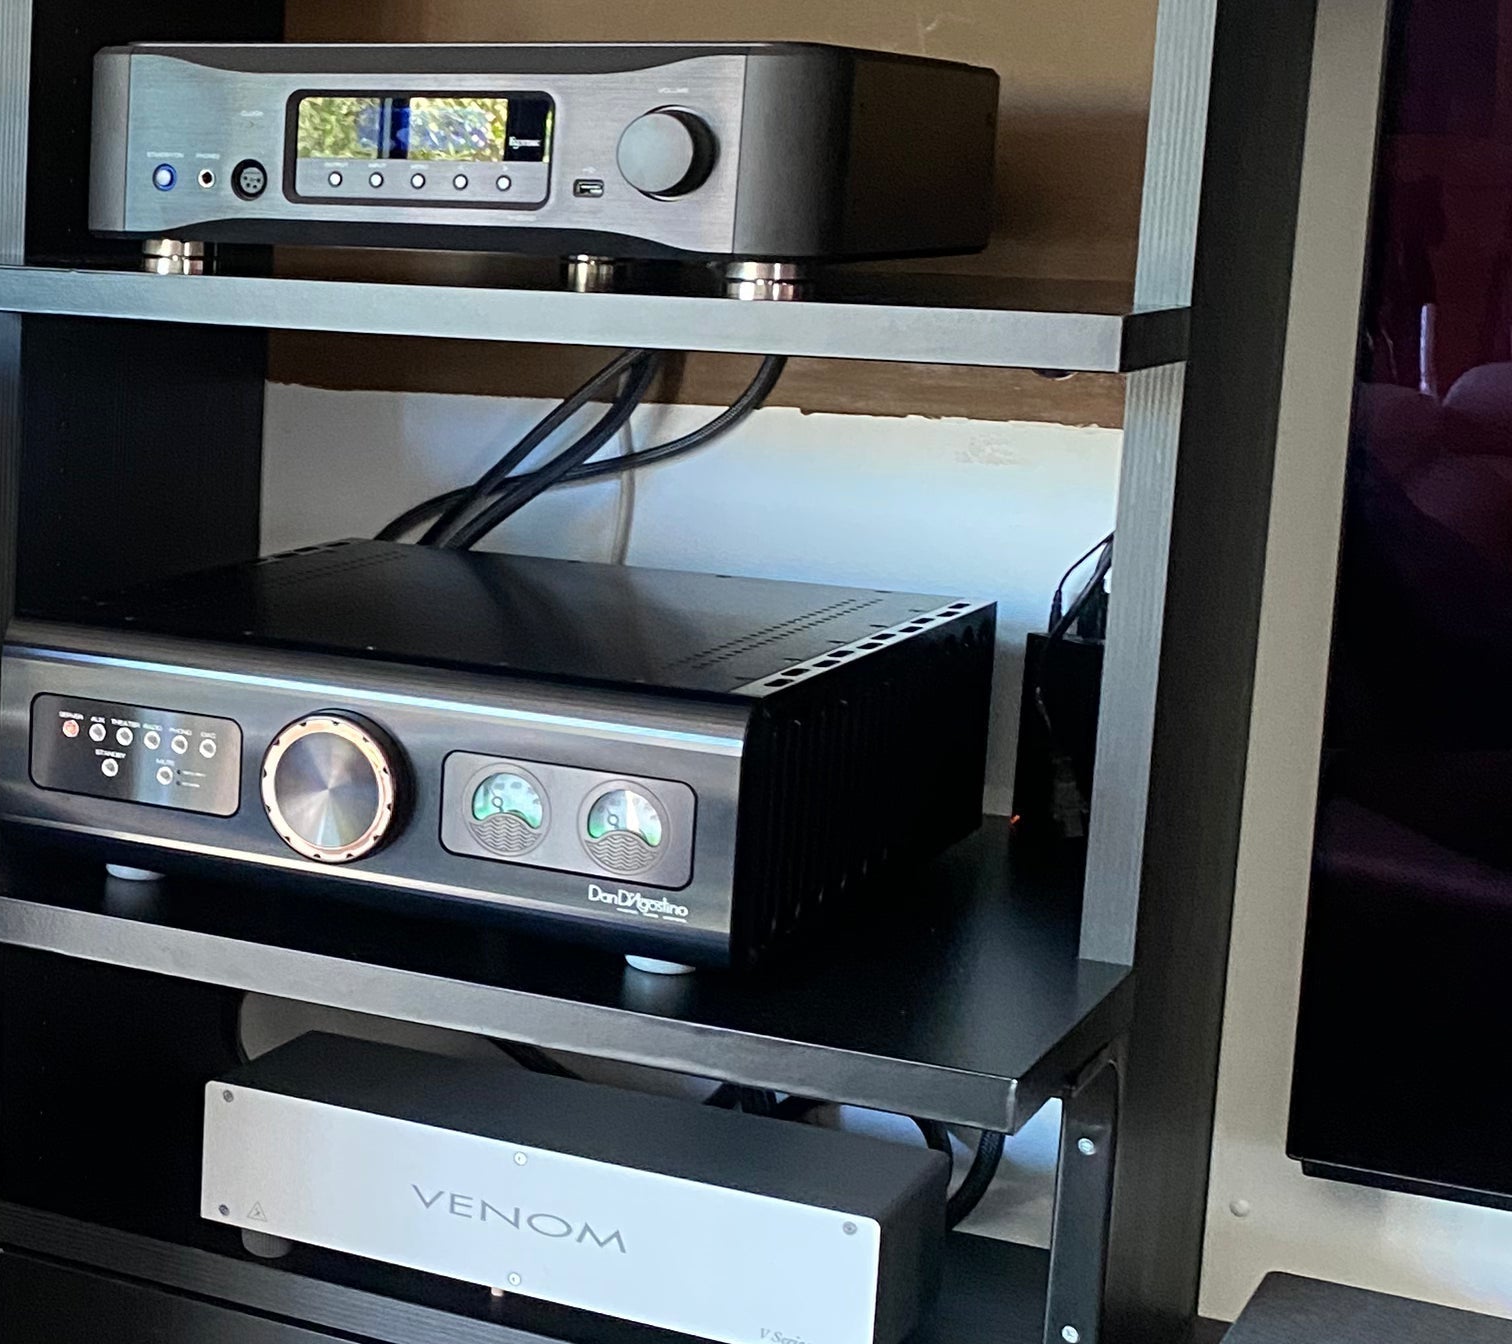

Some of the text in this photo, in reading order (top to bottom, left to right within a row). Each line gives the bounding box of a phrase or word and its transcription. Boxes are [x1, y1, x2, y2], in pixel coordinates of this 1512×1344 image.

[95, 748, 126, 759] STANDBY
[412, 1183, 626, 1254] VENOM
[760, 1327, 771, 1339] V
